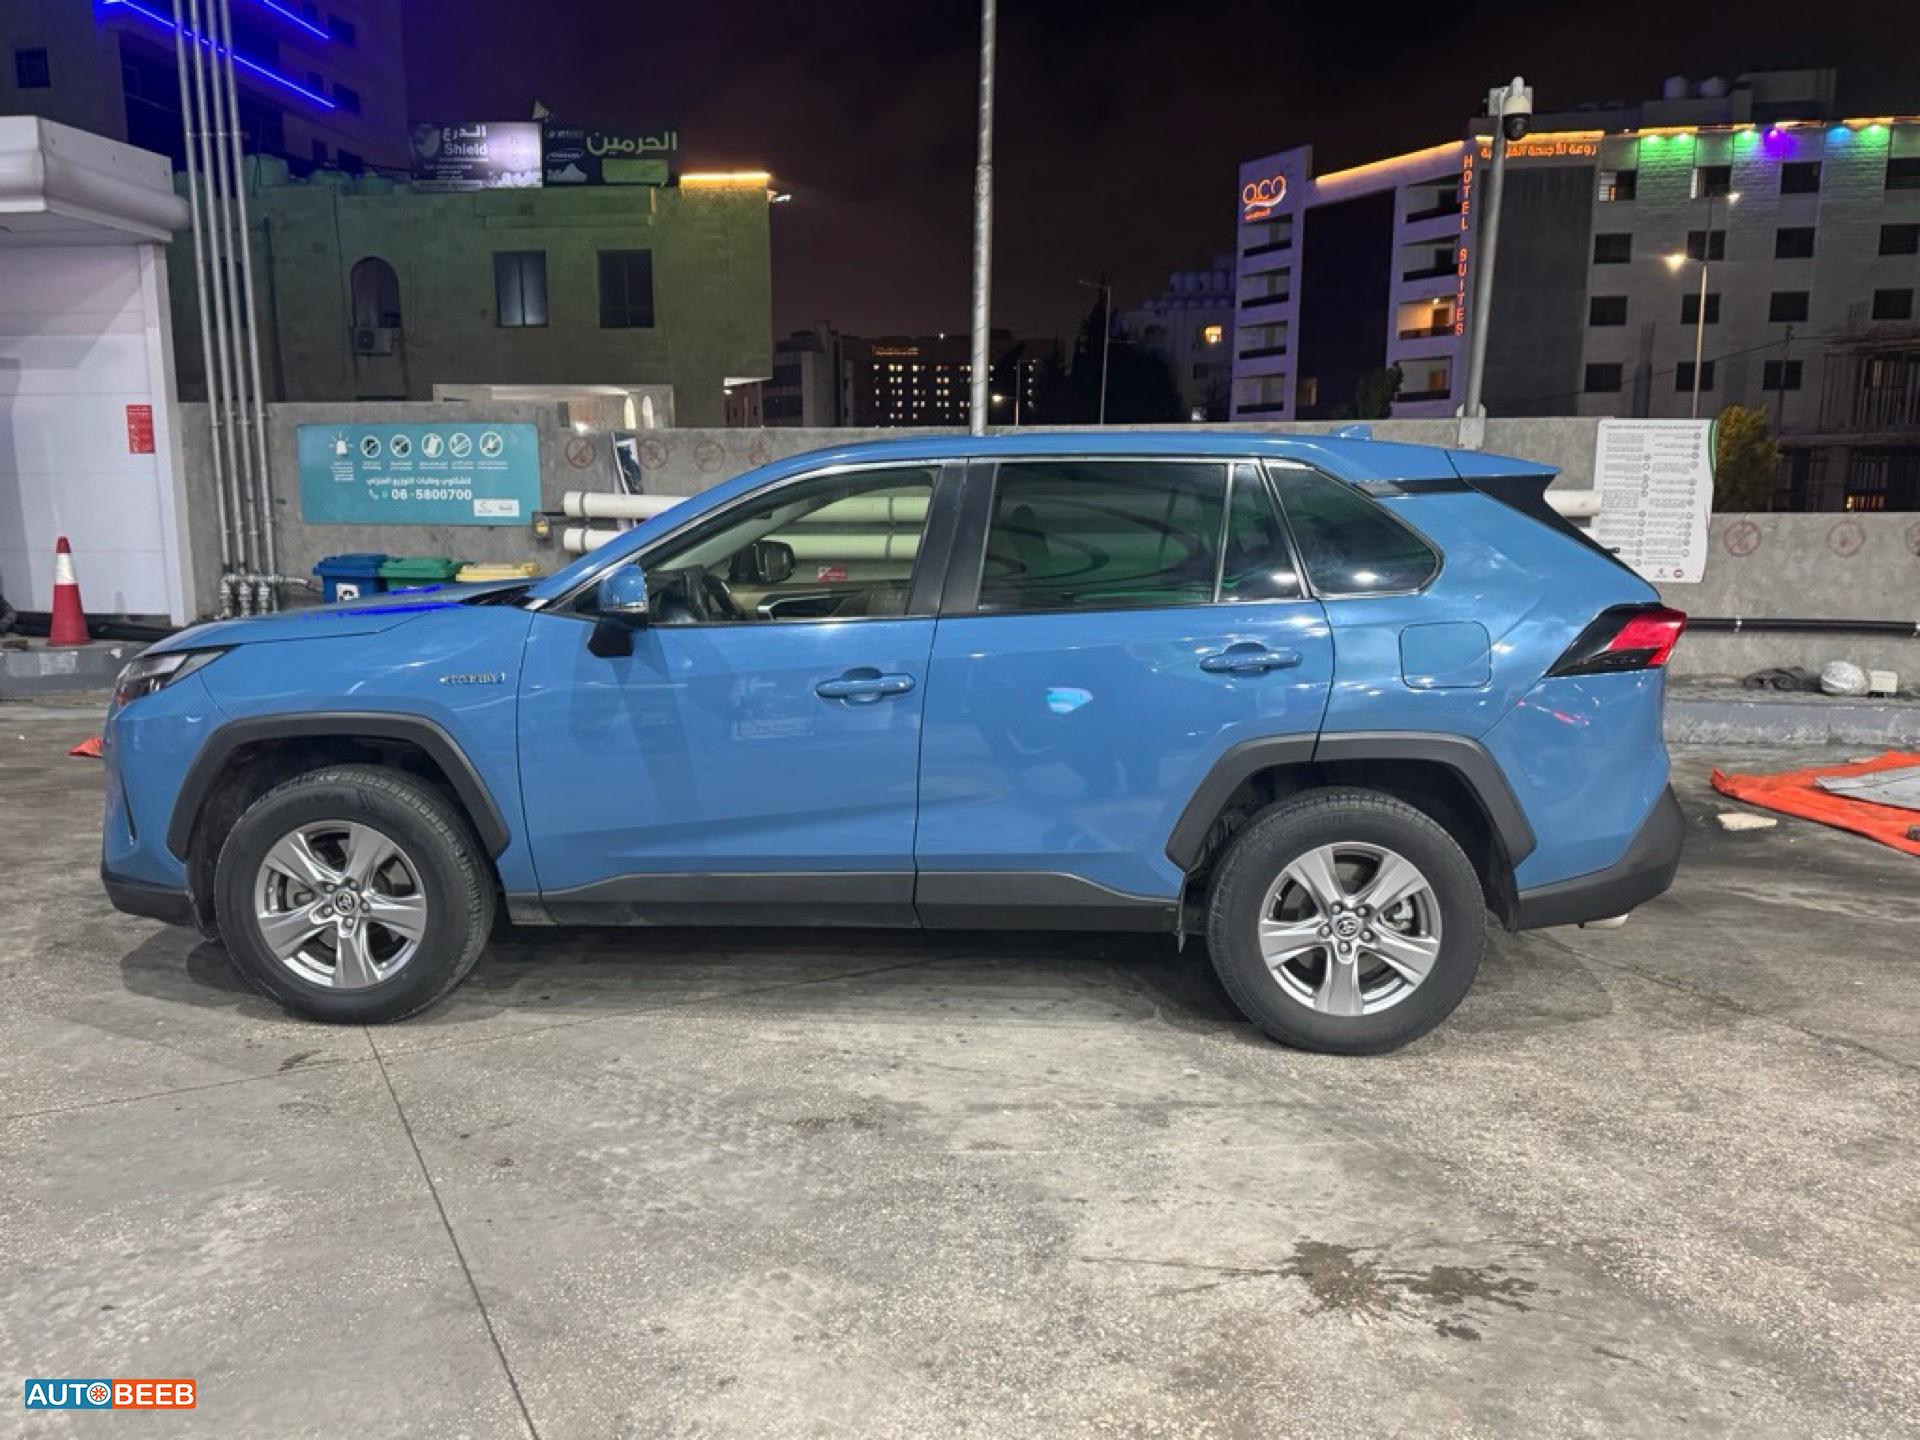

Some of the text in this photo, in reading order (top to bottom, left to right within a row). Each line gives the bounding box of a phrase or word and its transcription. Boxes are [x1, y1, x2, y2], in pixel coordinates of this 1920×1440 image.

[443, 143, 488, 155] Shield
[586, 131, 678, 156] الحرمين
[1455, 155, 1473, 336] HOTEL SUITES
